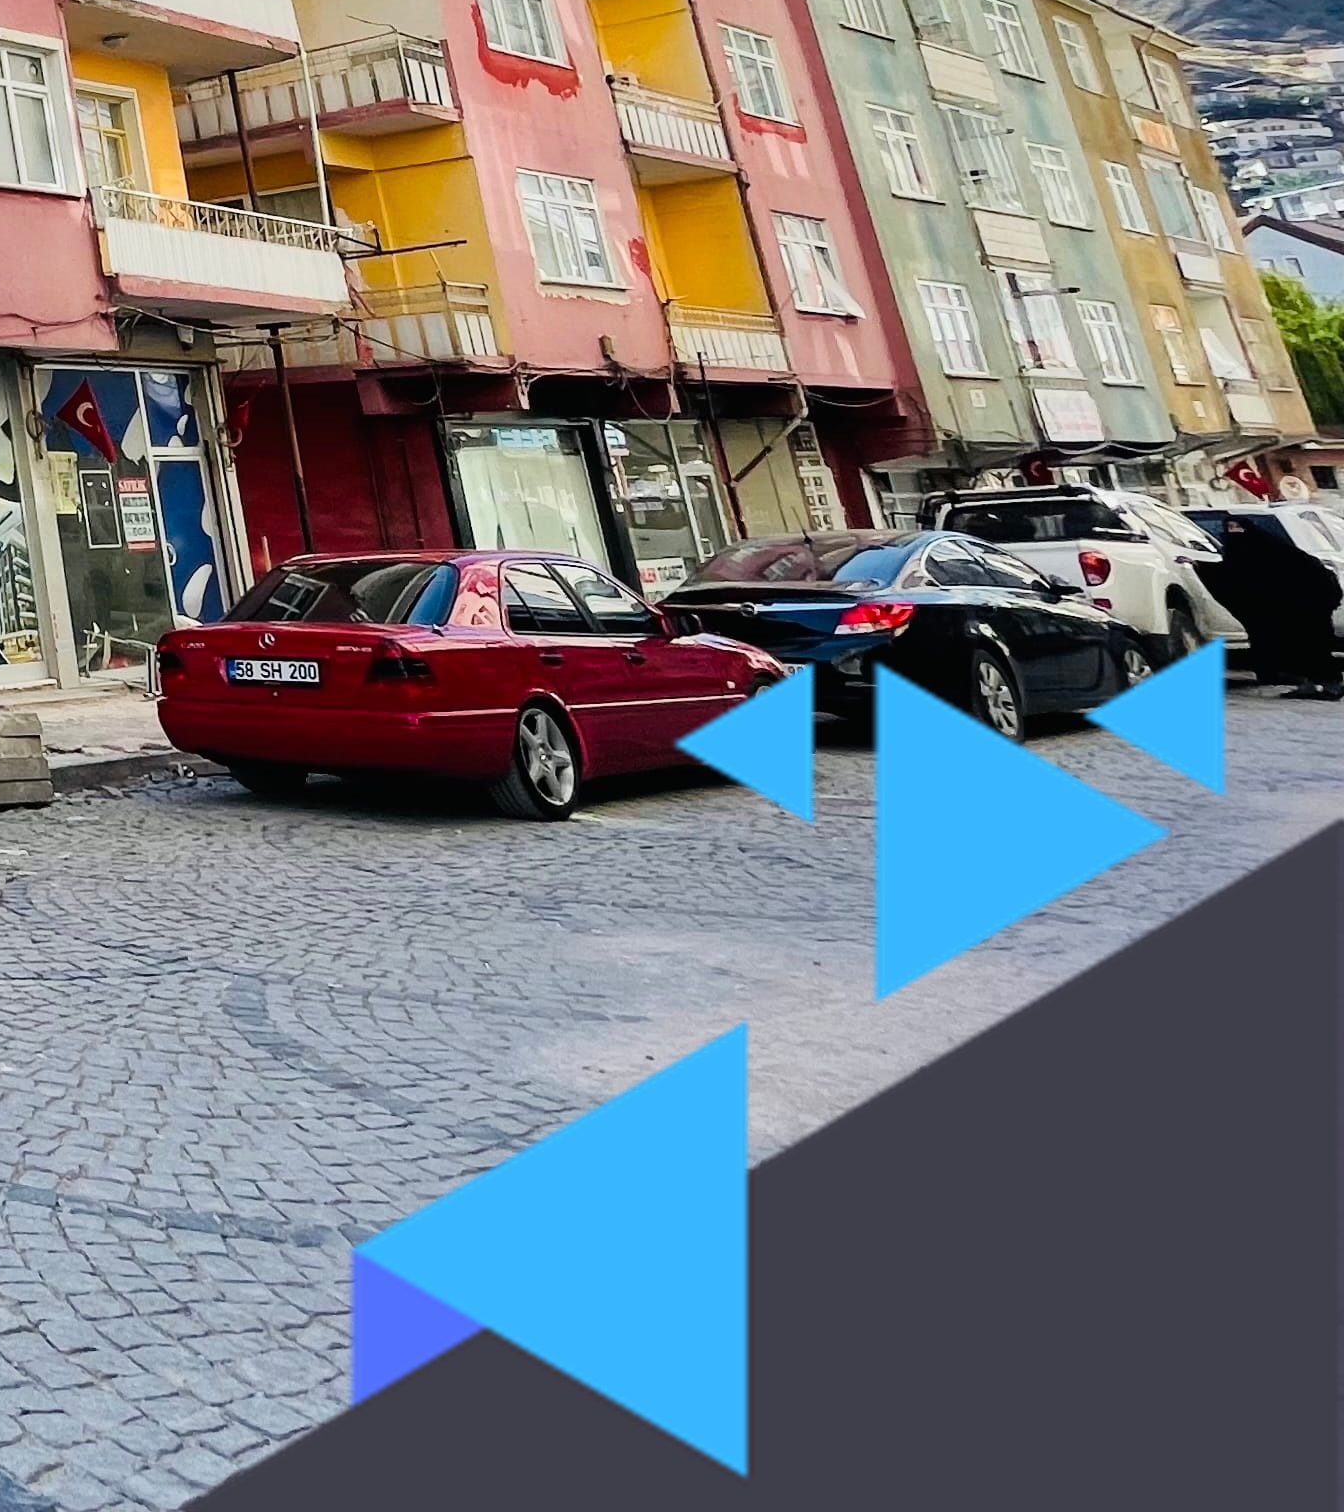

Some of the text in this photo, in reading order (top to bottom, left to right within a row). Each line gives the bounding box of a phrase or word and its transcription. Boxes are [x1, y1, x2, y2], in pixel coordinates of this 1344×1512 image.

[235, 661, 317, 680] 58 SH 200
